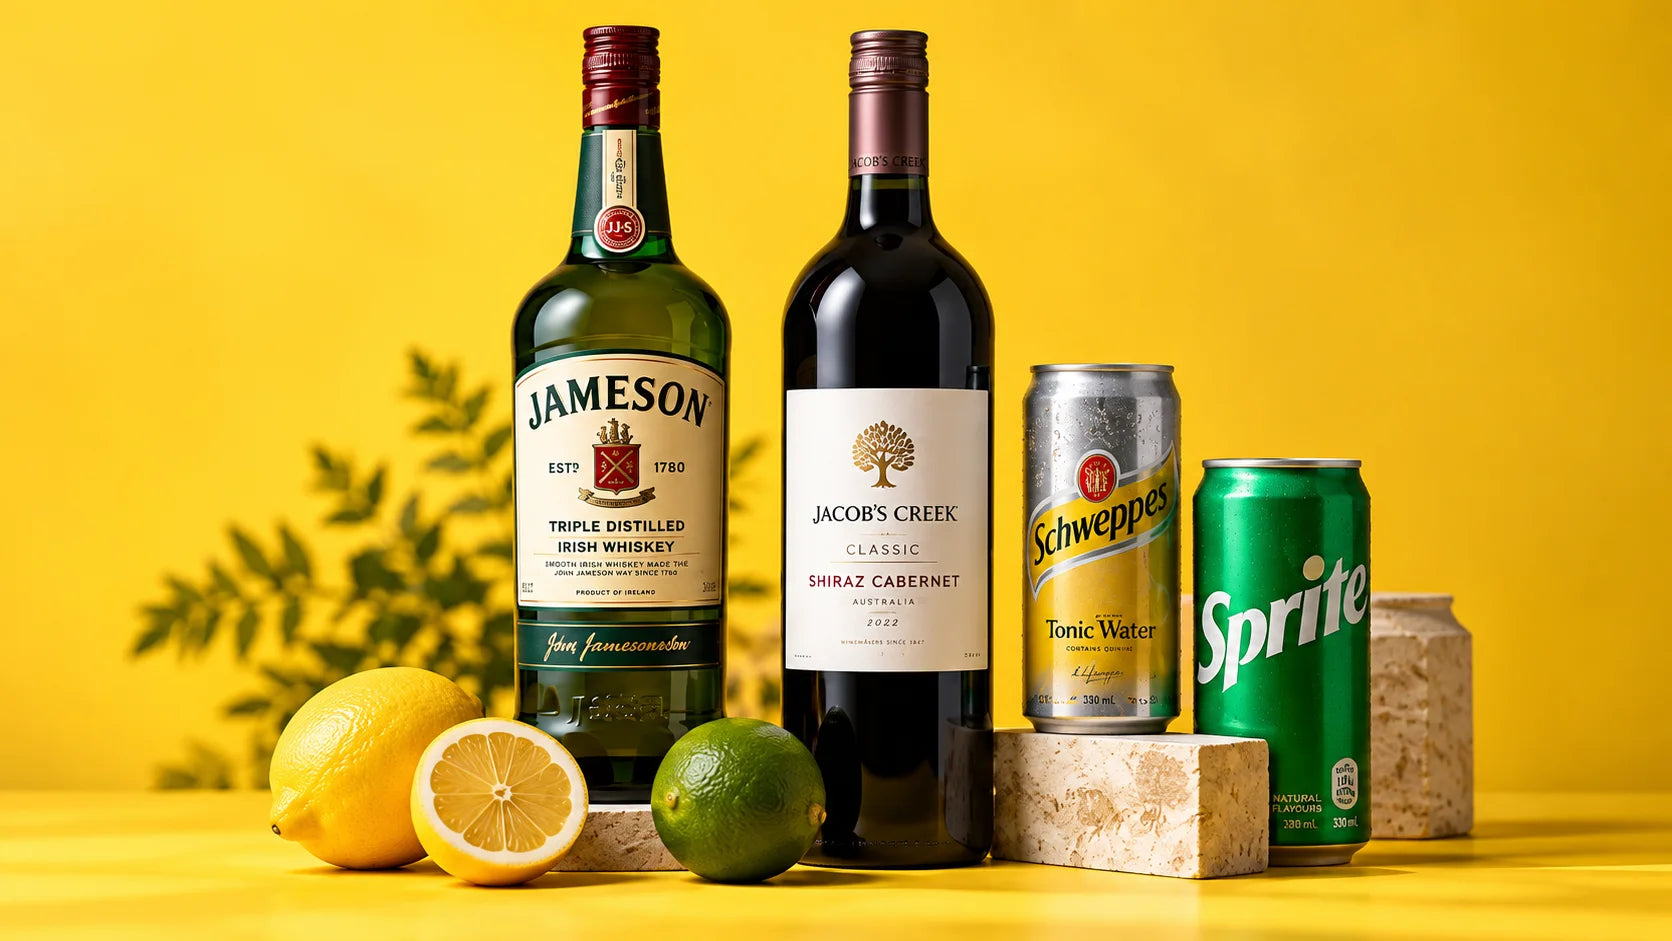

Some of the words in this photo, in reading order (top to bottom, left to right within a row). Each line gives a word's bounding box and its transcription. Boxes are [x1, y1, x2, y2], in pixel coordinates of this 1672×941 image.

[529, 375, 709, 430] JAMESON
[654, 461, 685, 473] 1780
[813, 504, 887, 524] JACOB'S
[894, 505, 957, 522] CREEK
[549, 520, 601, 532] TRIPLE
[606, 520, 685, 532] DISTILLED
[1034, 482, 1168, 566] Schweppes
[558, 541, 598, 553] IRISH
[602, 541, 675, 553] WHISKEY
[846, 544, 920, 556] CLASSIC
[809, 574, 865, 588] SHIRAZ
[872, 574, 960, 588] CABERNET
[852, 598, 915, 606] AUSTRALIA
[866, 618, 899, 627] 2022
[1197, 555, 1368, 693] Sprite
[1046, 619, 1094, 639] Tonic
[1096, 619, 1156, 639] Water
[1272, 794, 1322, 803] NATURAL
